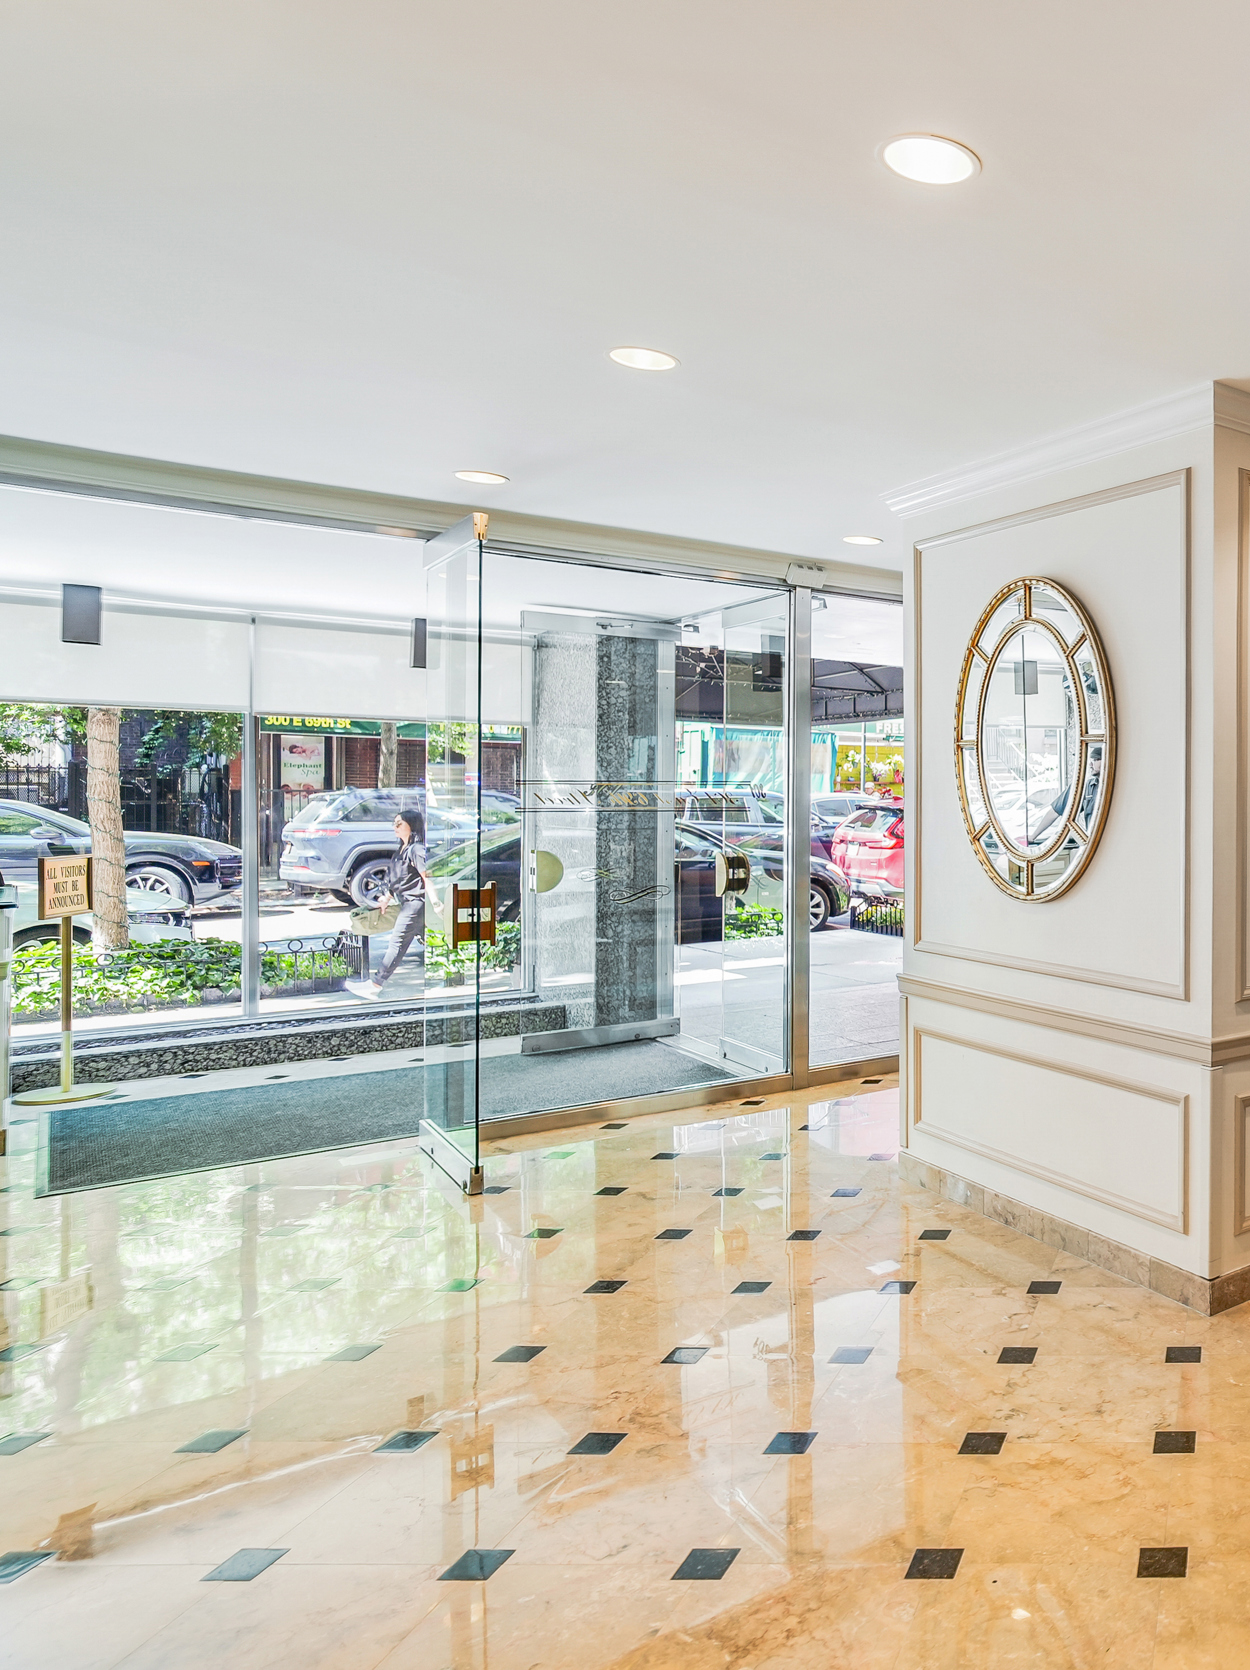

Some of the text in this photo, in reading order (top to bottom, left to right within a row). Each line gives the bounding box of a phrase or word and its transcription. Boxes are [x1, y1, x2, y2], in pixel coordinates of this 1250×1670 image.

[264, 715, 351, 729] 300 E 69th St
[300, 769, 321, 777] Spa
[46, 865, 86, 880] ALL VISITORS
[53, 880, 79, 894] MUST BE
[48, 894, 85, 909] ANNOUNCED
